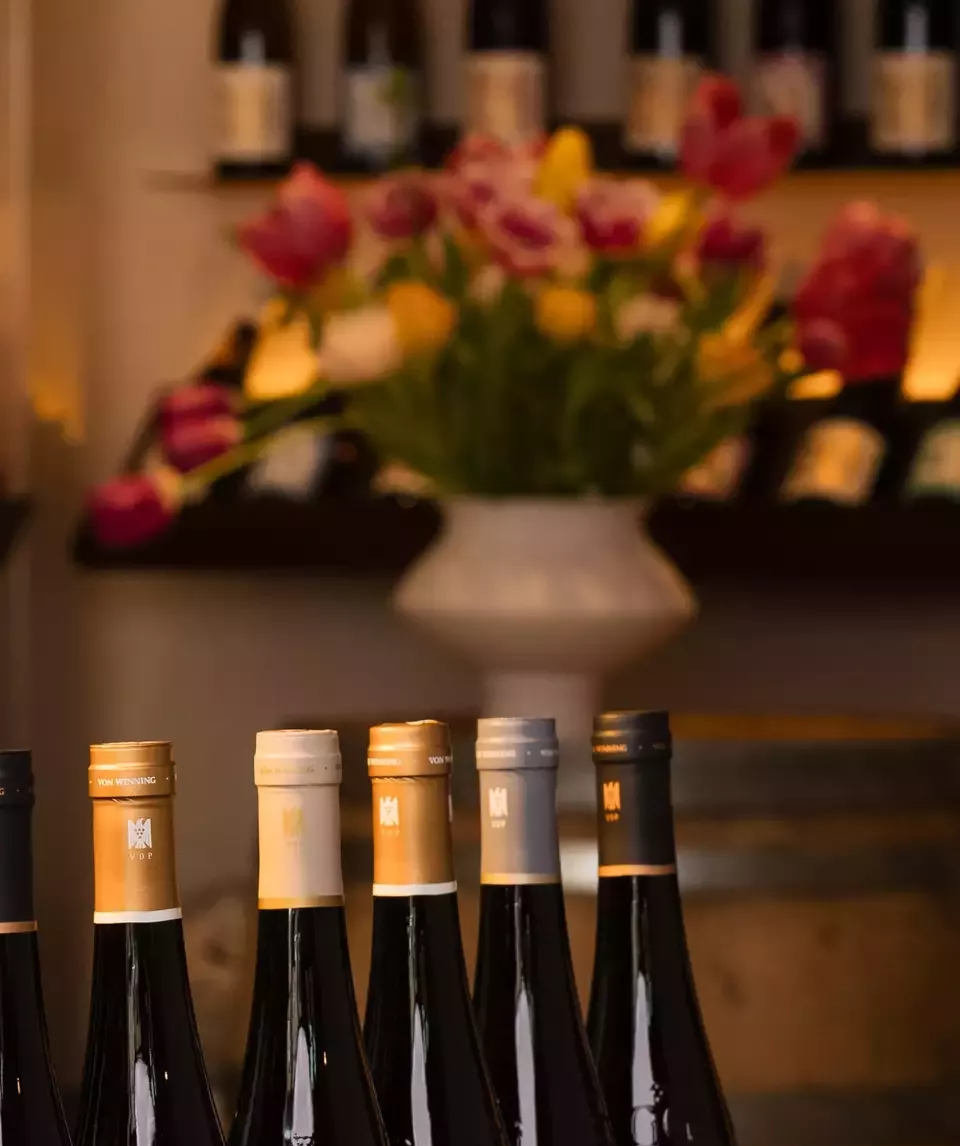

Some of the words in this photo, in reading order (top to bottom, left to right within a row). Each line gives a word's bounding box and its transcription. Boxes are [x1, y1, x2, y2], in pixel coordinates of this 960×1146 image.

[97, 778, 114, 786] VON
[115, 777, 157, 785] WINNING
[129, 852, 153, 860] VDP
